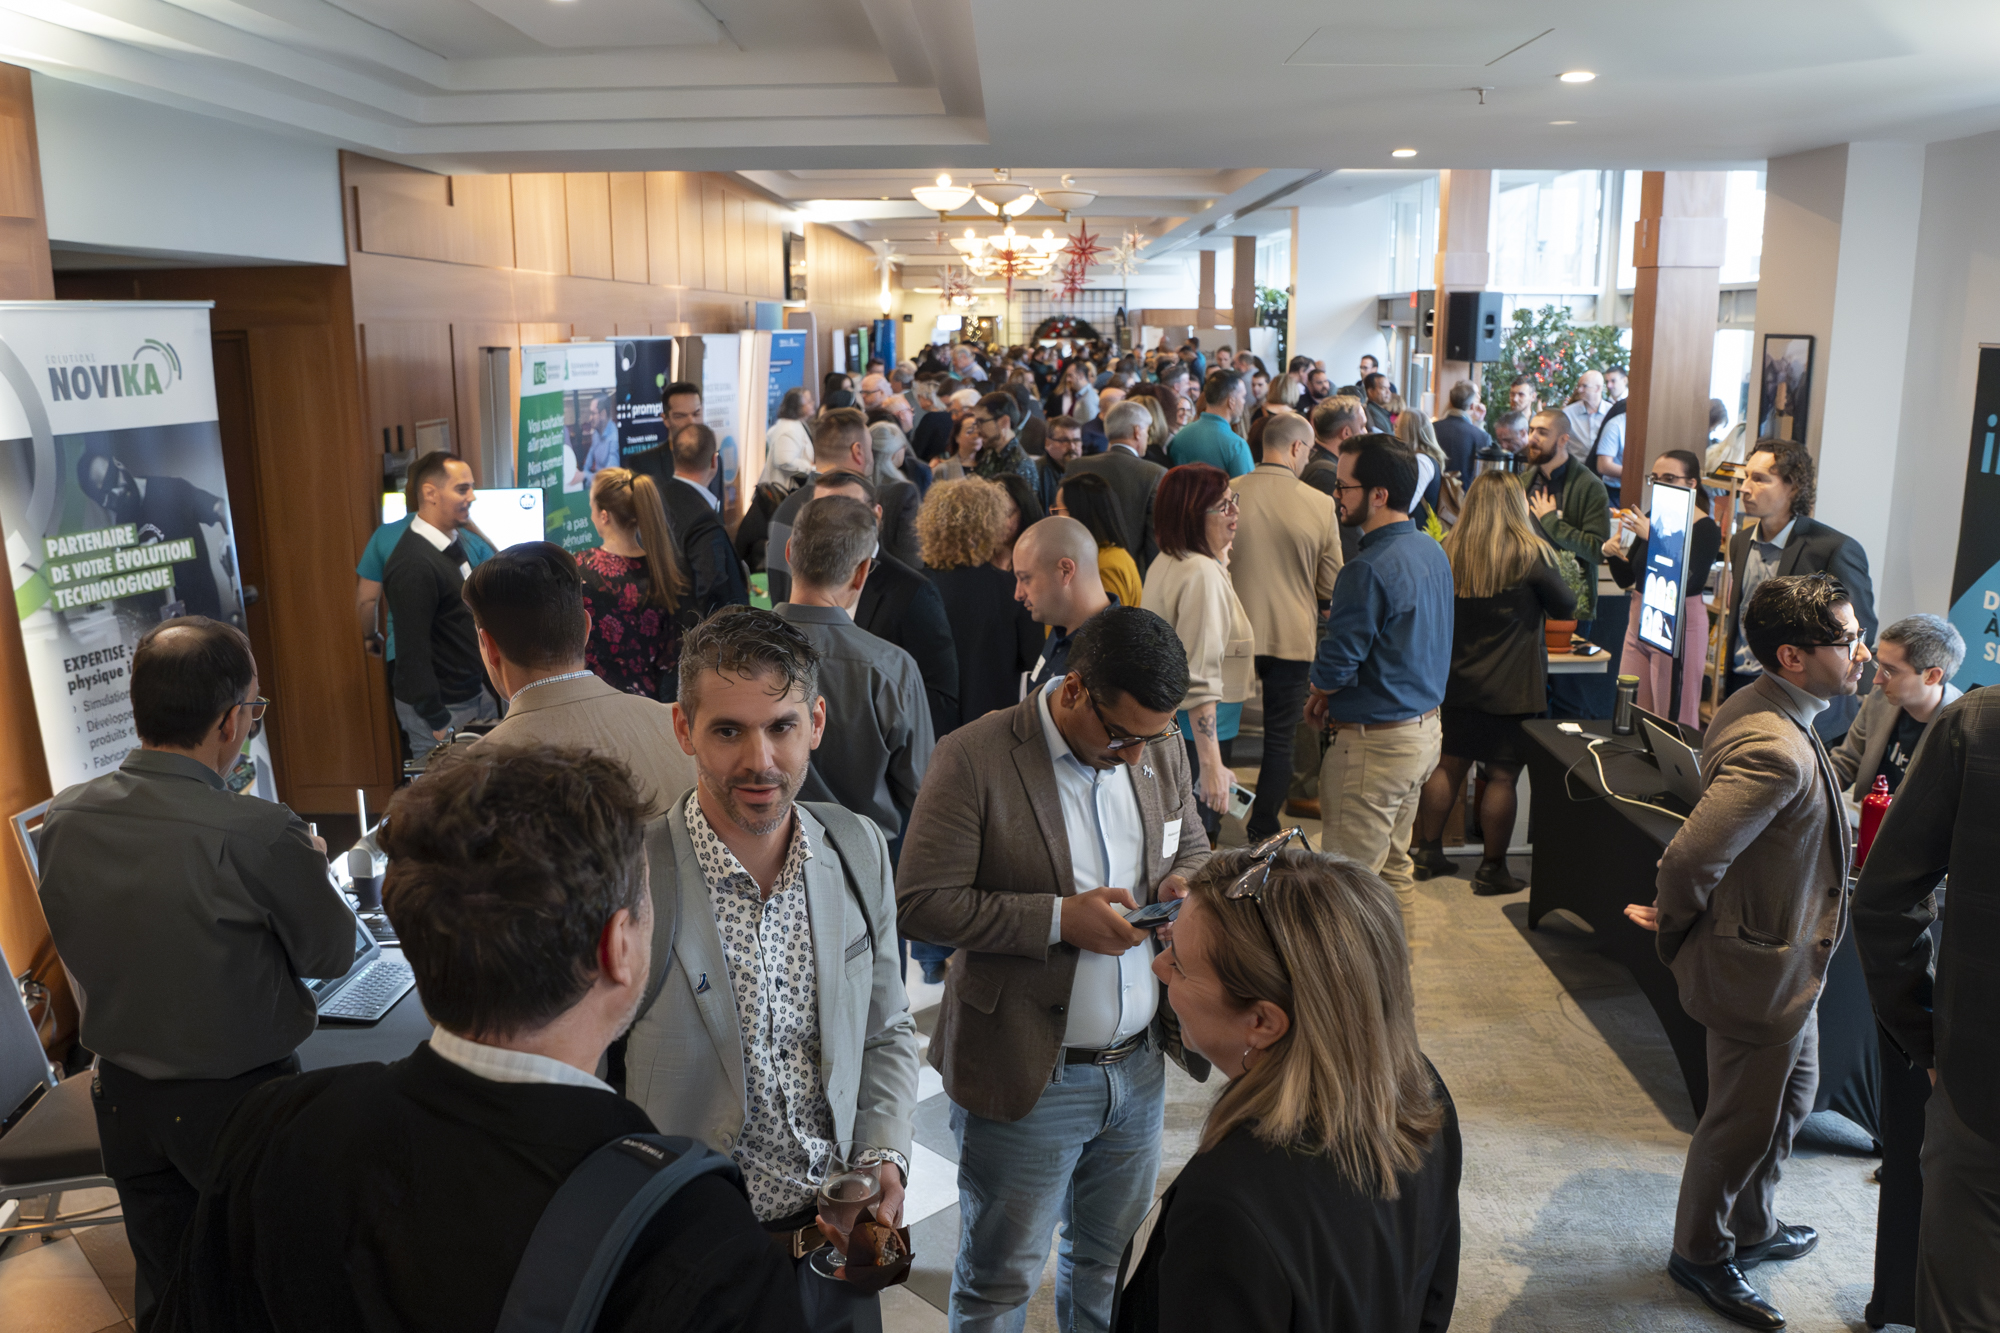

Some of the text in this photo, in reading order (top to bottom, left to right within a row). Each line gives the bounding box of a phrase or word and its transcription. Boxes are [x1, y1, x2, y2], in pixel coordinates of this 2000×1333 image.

[48, 363, 163, 402] NOVIKA
[573, 517, 589, 532] pas
[46, 525, 135, 559] PARTENAIRE
[51, 540, 192, 584] DE VOTRE ÉVOLUTION
[55, 568, 171, 609] TECHNOLOGIQUE
[1983, 590, 2000, 611] D
[63, 644, 125, 673] EXPERTISE
[67, 667, 124, 695] physique
